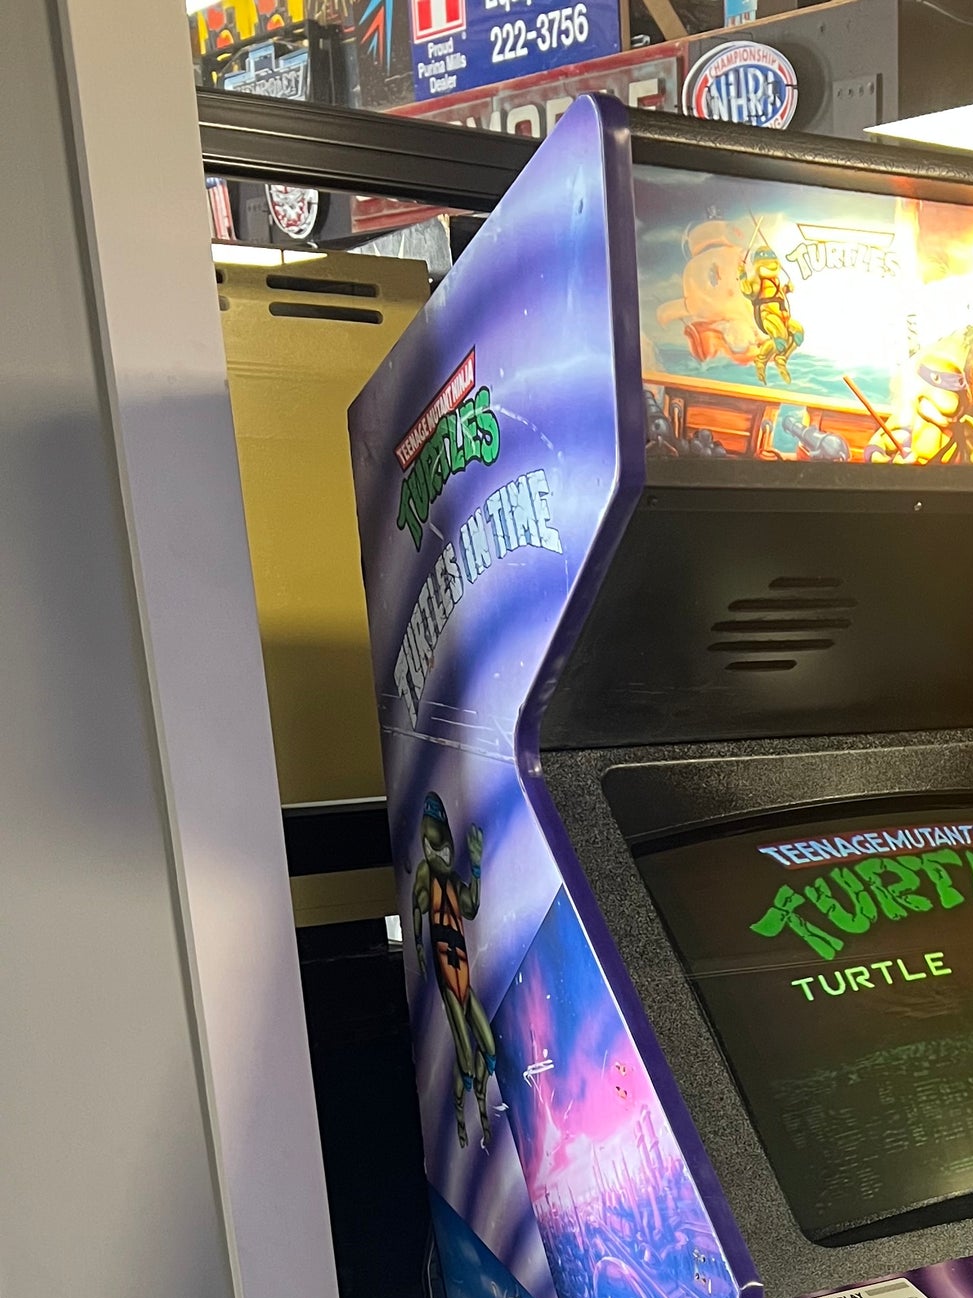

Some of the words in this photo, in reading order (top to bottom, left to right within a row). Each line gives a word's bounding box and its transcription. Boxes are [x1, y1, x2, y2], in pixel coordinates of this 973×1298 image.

[428, 37, 454, 58] Proud
[490, 3, 589, 63] 222-3756
[430, 74, 457, 93] Dealer
[709, 49, 777, 78] CHAMPIONSHIP
[397, 421, 433, 465] TEENAGE
[428, 387, 453, 427] MUTANT
[449, 359, 475, 406] NINJA
[397, 386, 499, 552] TURTLES
[394, 541, 464, 730] TURTLES
[460, 508, 492, 584] IN
[486, 469, 563, 559] TIME
[759, 832, 891, 867] TEENAGE
[886, 825, 973, 851] MUTANT
[791, 951, 952, 1001] TURTLE
